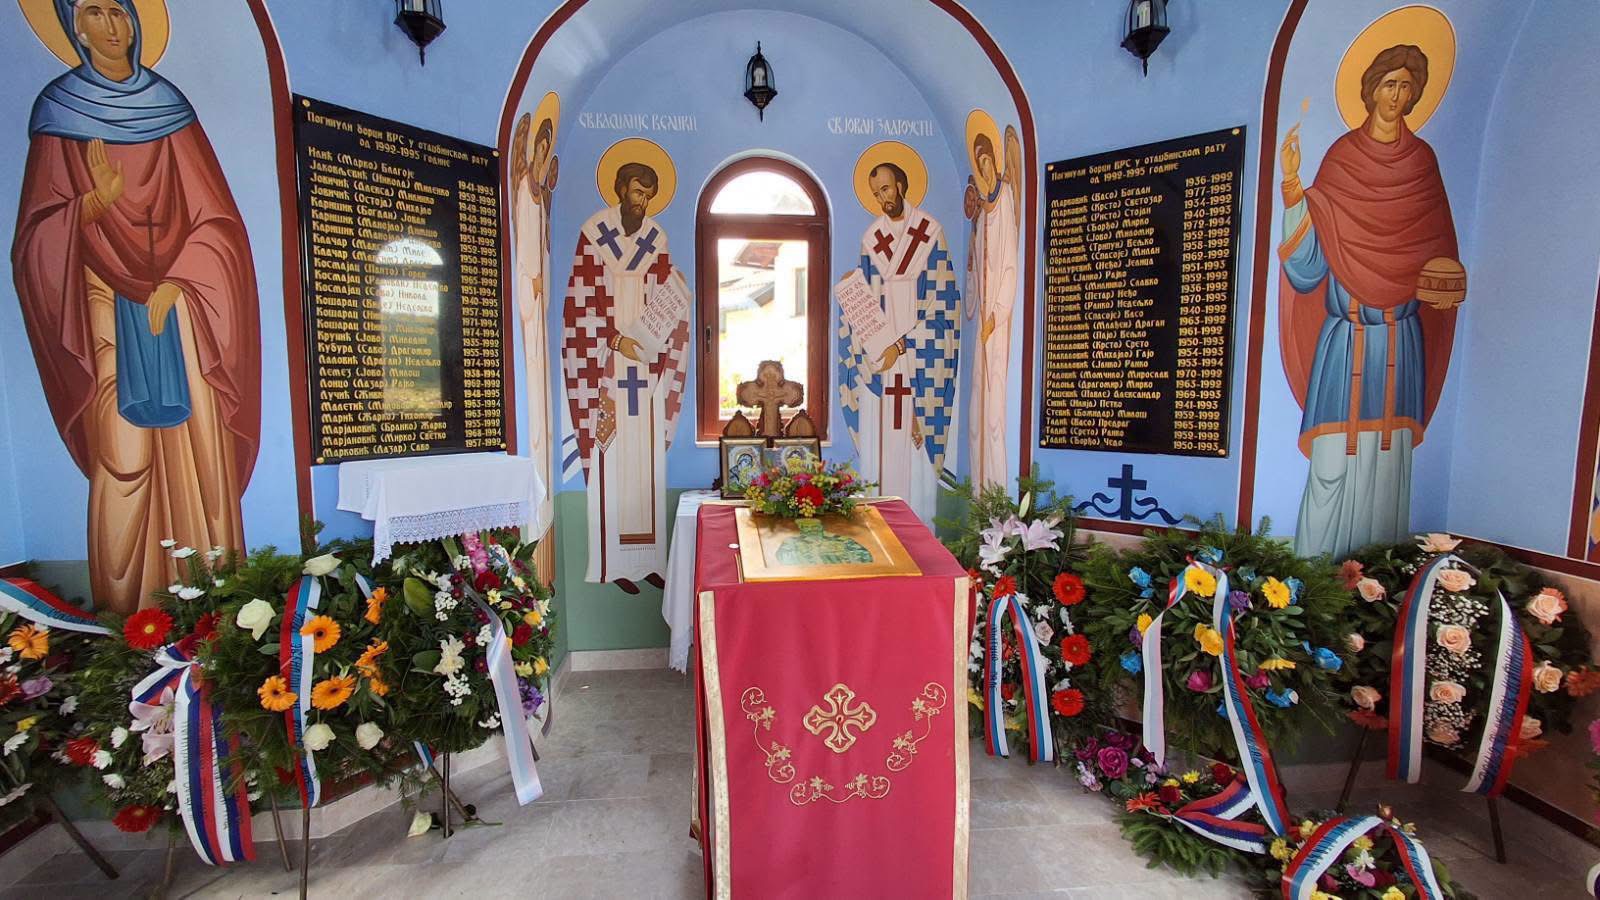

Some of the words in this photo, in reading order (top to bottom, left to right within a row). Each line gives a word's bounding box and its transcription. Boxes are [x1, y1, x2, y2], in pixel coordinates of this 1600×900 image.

[307, 111, 353, 133] Погинули
[387, 132, 405, 146] ВРС
[471, 154, 489, 167] рату
[359, 137, 370, 149] од
[375, 141, 420, 161] 1992-1995
[1114, 159, 1131, 171] ВРС
[1205, 141, 1226, 155] рату
[1090, 176, 1100, 185] од
[1104, 167, 1145, 183] 1992-1995
[1091, 190, 1118, 203] (Васо)
[1121, 185, 1151, 198] Богдан
[1125, 193, 1163, 208] Светозар
[1185, 183, 1233, 198] 1977-1995
[1124, 206, 1152, 218] Стојан
[1183, 216, 1231, 230] 1972-1994
[1132, 246, 1160, 257] Милан
[1182, 238, 1230, 251] 1958-1992
[1182, 249, 1229, 262] 1962-1992
[1085, 291, 1114, 301] (Петар)
[1117, 298, 1154, 309] Недељко
[1124, 309, 1144, 318] Васо
[1135, 318, 1165, 328] Драган
[1179, 326, 1222, 336] 1961-1992
[1125, 340, 1149, 349] Срето
[1136, 350, 1154, 358] Гајо
[1177, 369, 1223, 378] 1970-1992
